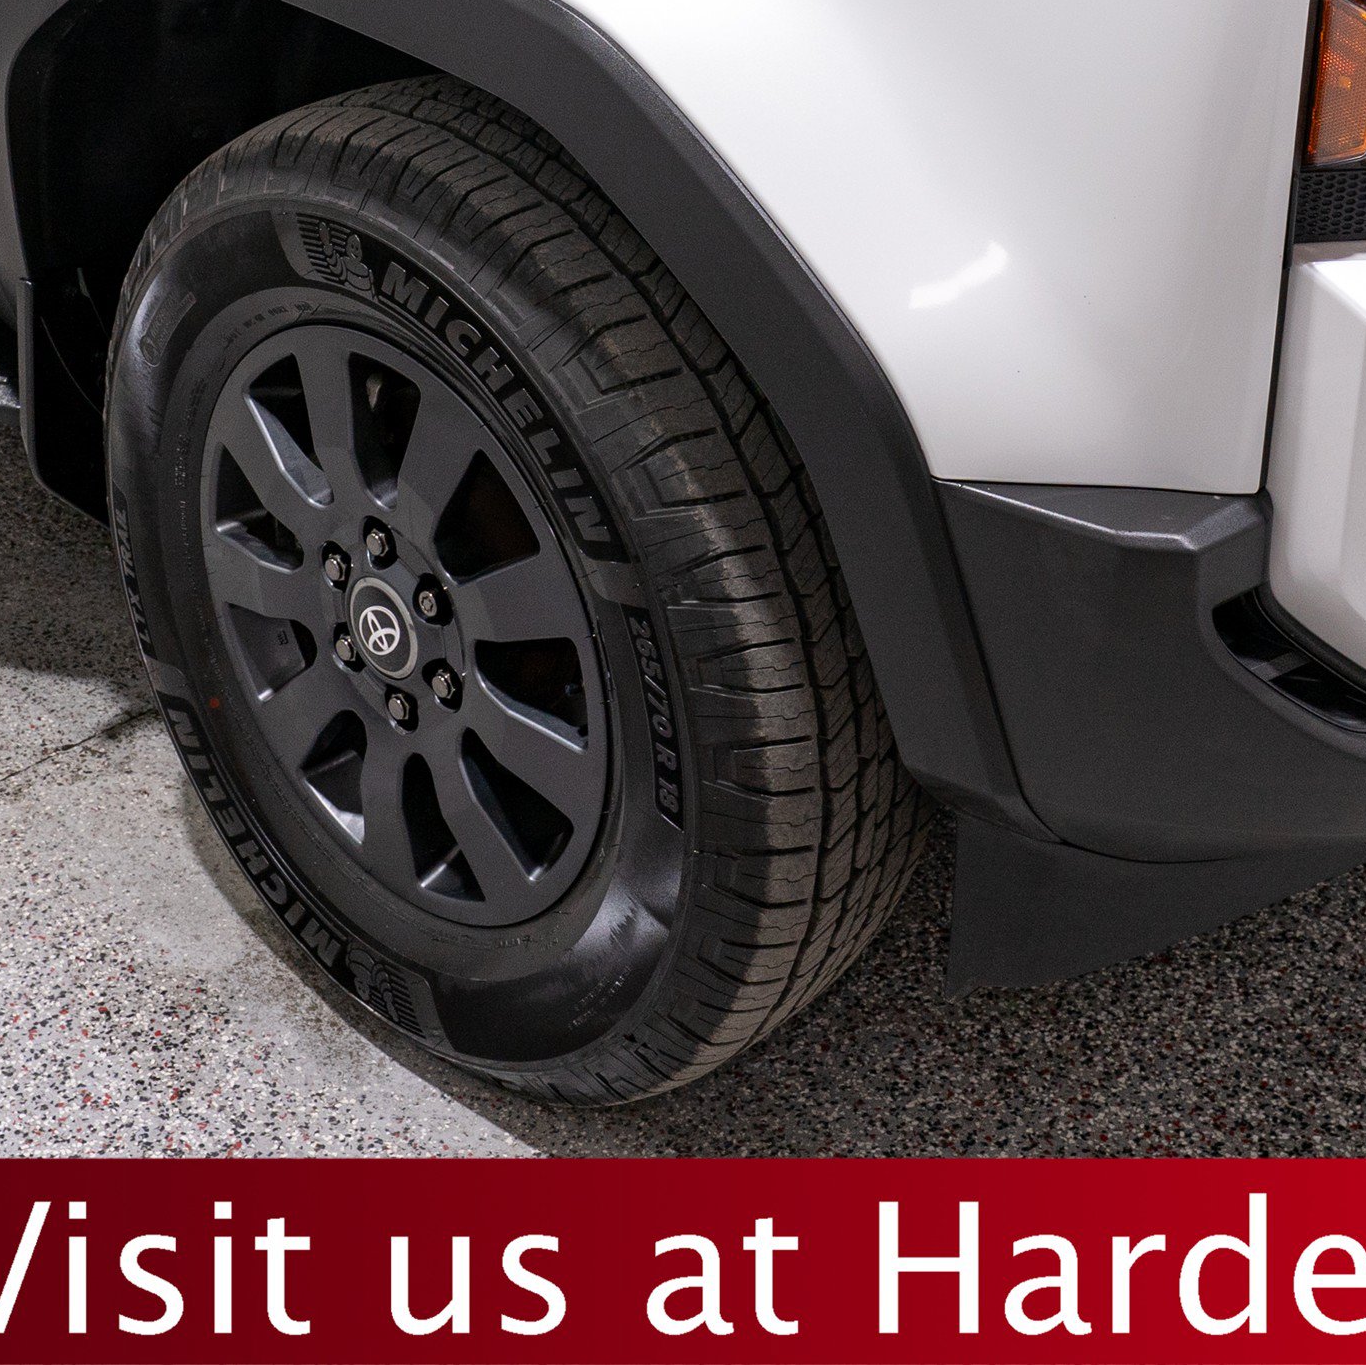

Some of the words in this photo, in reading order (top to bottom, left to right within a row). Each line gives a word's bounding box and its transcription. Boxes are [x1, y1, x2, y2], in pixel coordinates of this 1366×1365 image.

[381, 260, 611, 542] MICHELIN
[115, 508, 136, 579] TRAIL
[127, 587, 151, 643] LTX
[628, 616, 673, 739] 265/70
[655, 741, 677, 771] R
[658, 777, 680, 814] 18
[166, 706, 344, 968] MICHELIN
